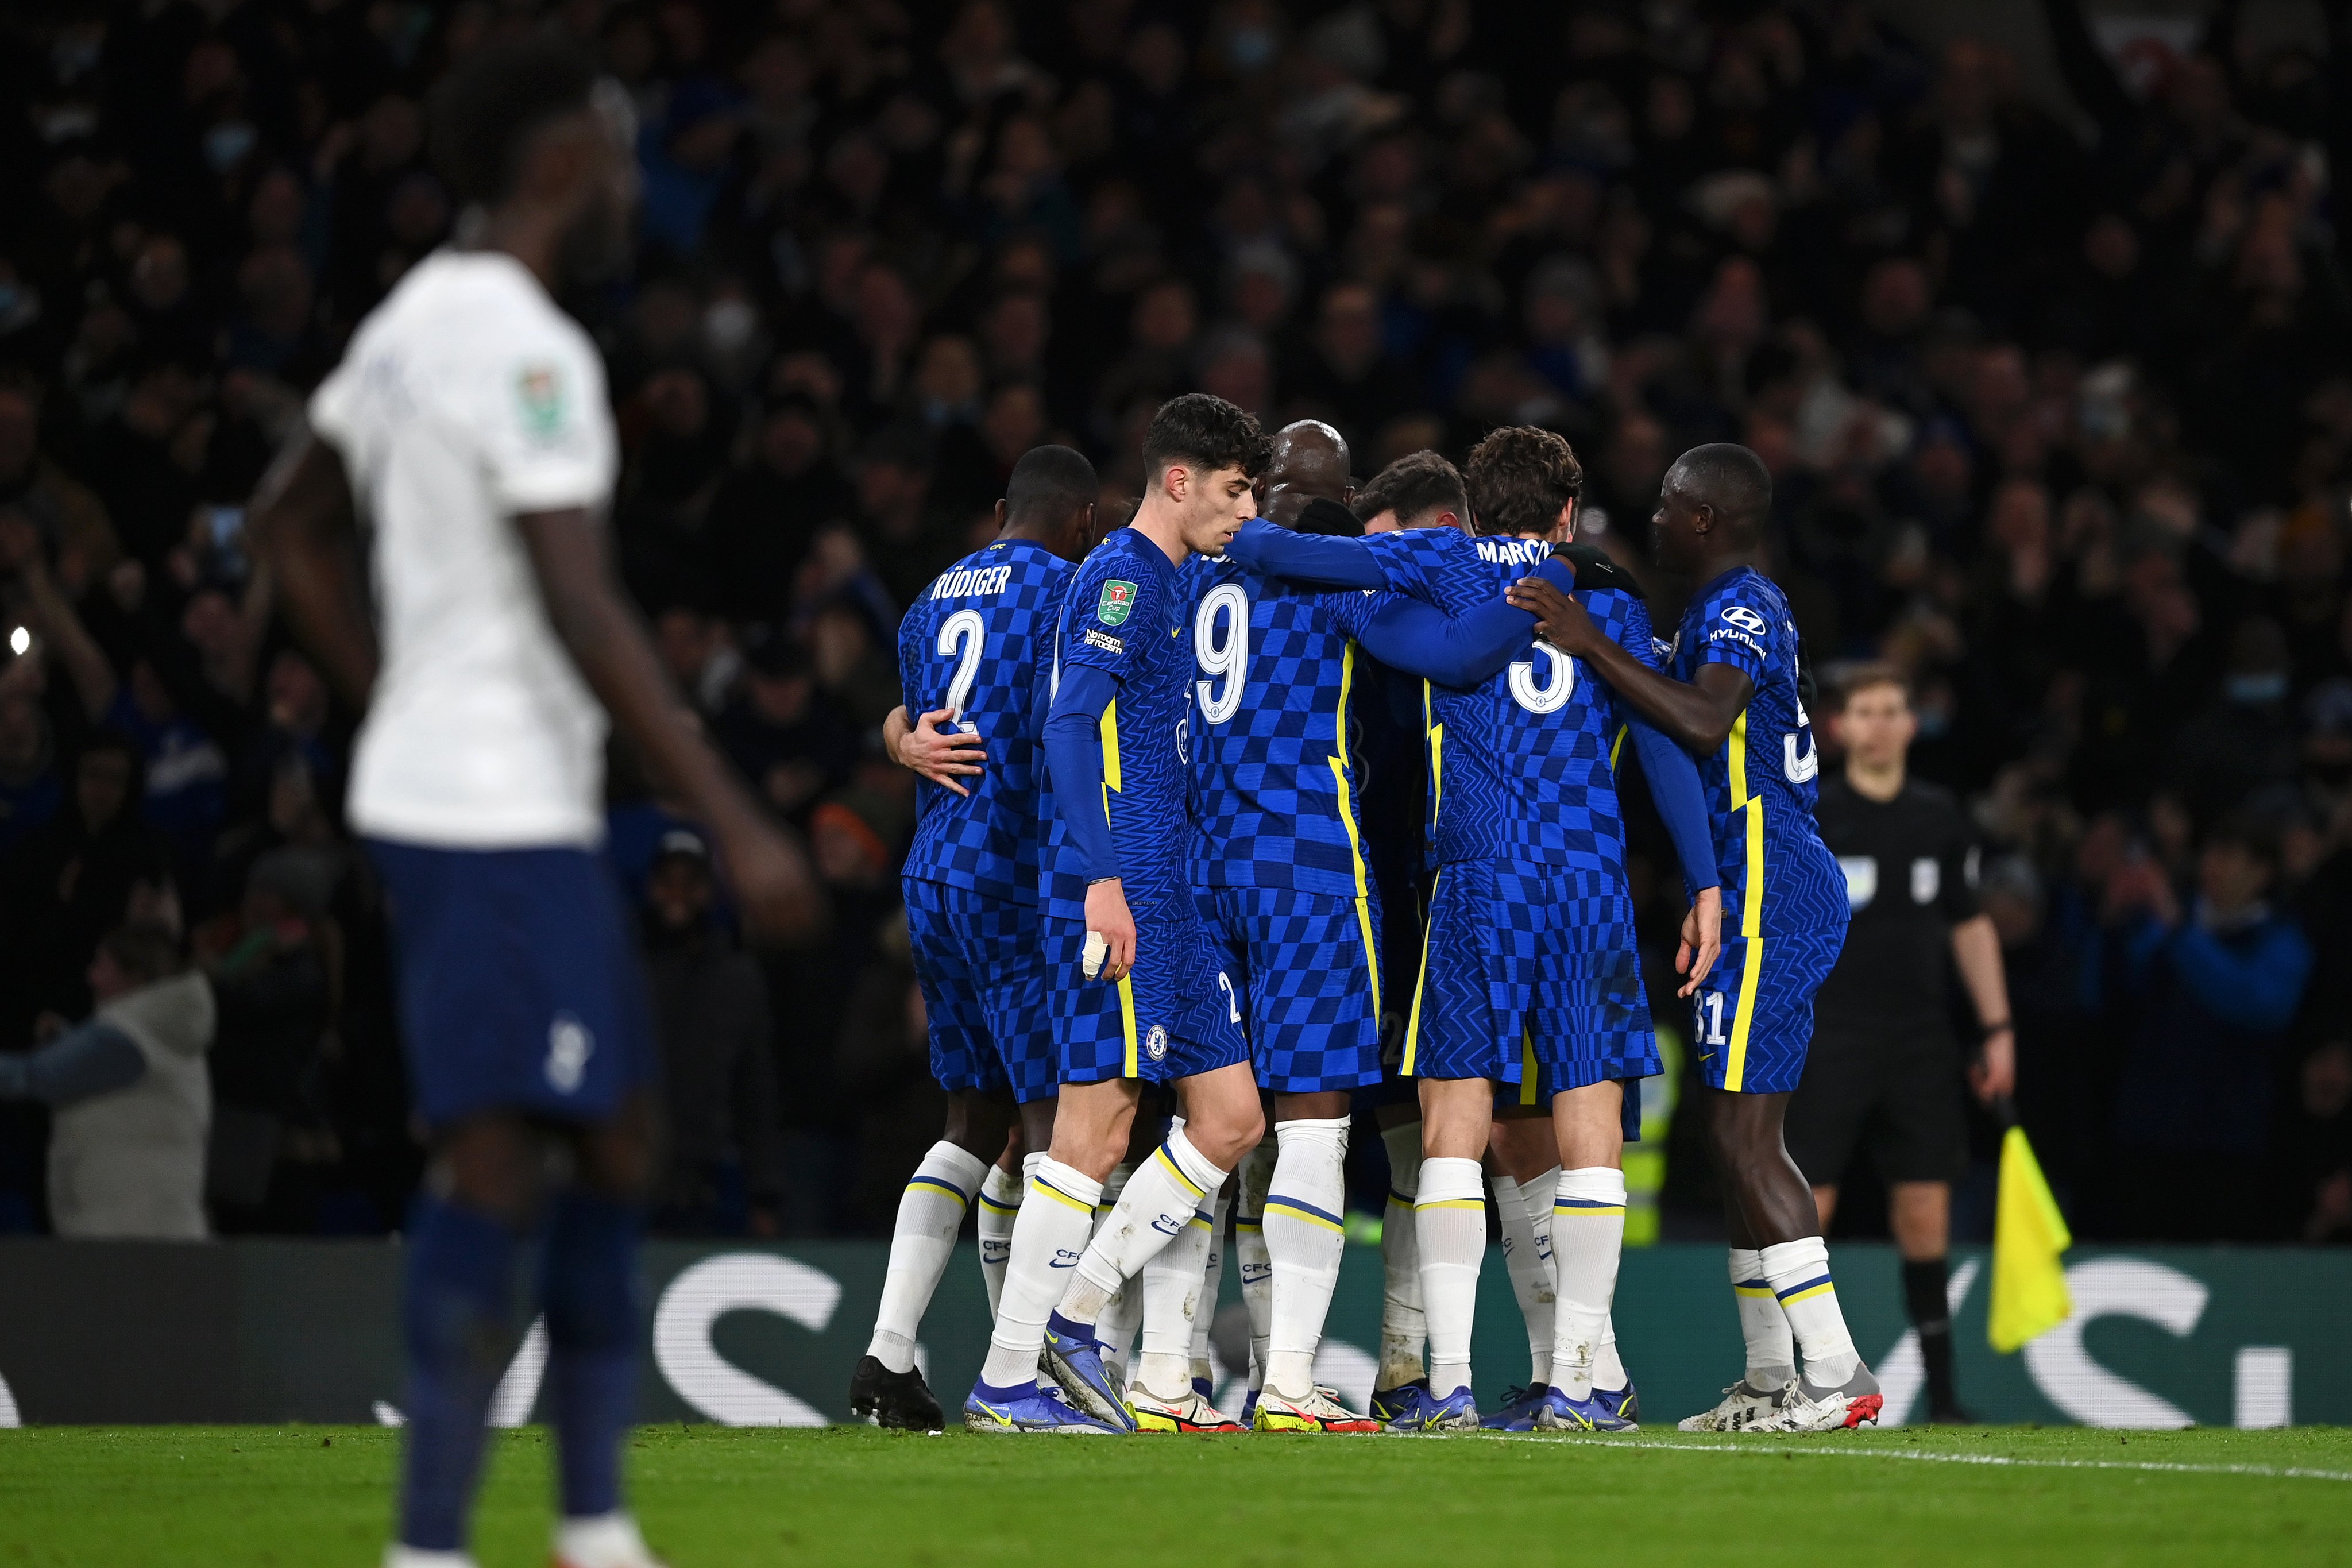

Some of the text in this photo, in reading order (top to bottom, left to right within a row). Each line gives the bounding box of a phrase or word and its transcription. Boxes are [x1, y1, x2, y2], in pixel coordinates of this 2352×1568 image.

[1476, 539, 1554, 566] MARCO
[930, 565, 1012, 601] RÜDIGER
[1084, 636, 1123, 655] for racism
[1086, 629, 1121, 647] No room
[1710, 629, 1767, 661] HYUNDAI
[1195, 584, 1249, 725] 9
[937, 609, 984, 736] 2
[1694, 988, 1726, 1045] 31
[1534, 1235, 1549, 1246] CF
